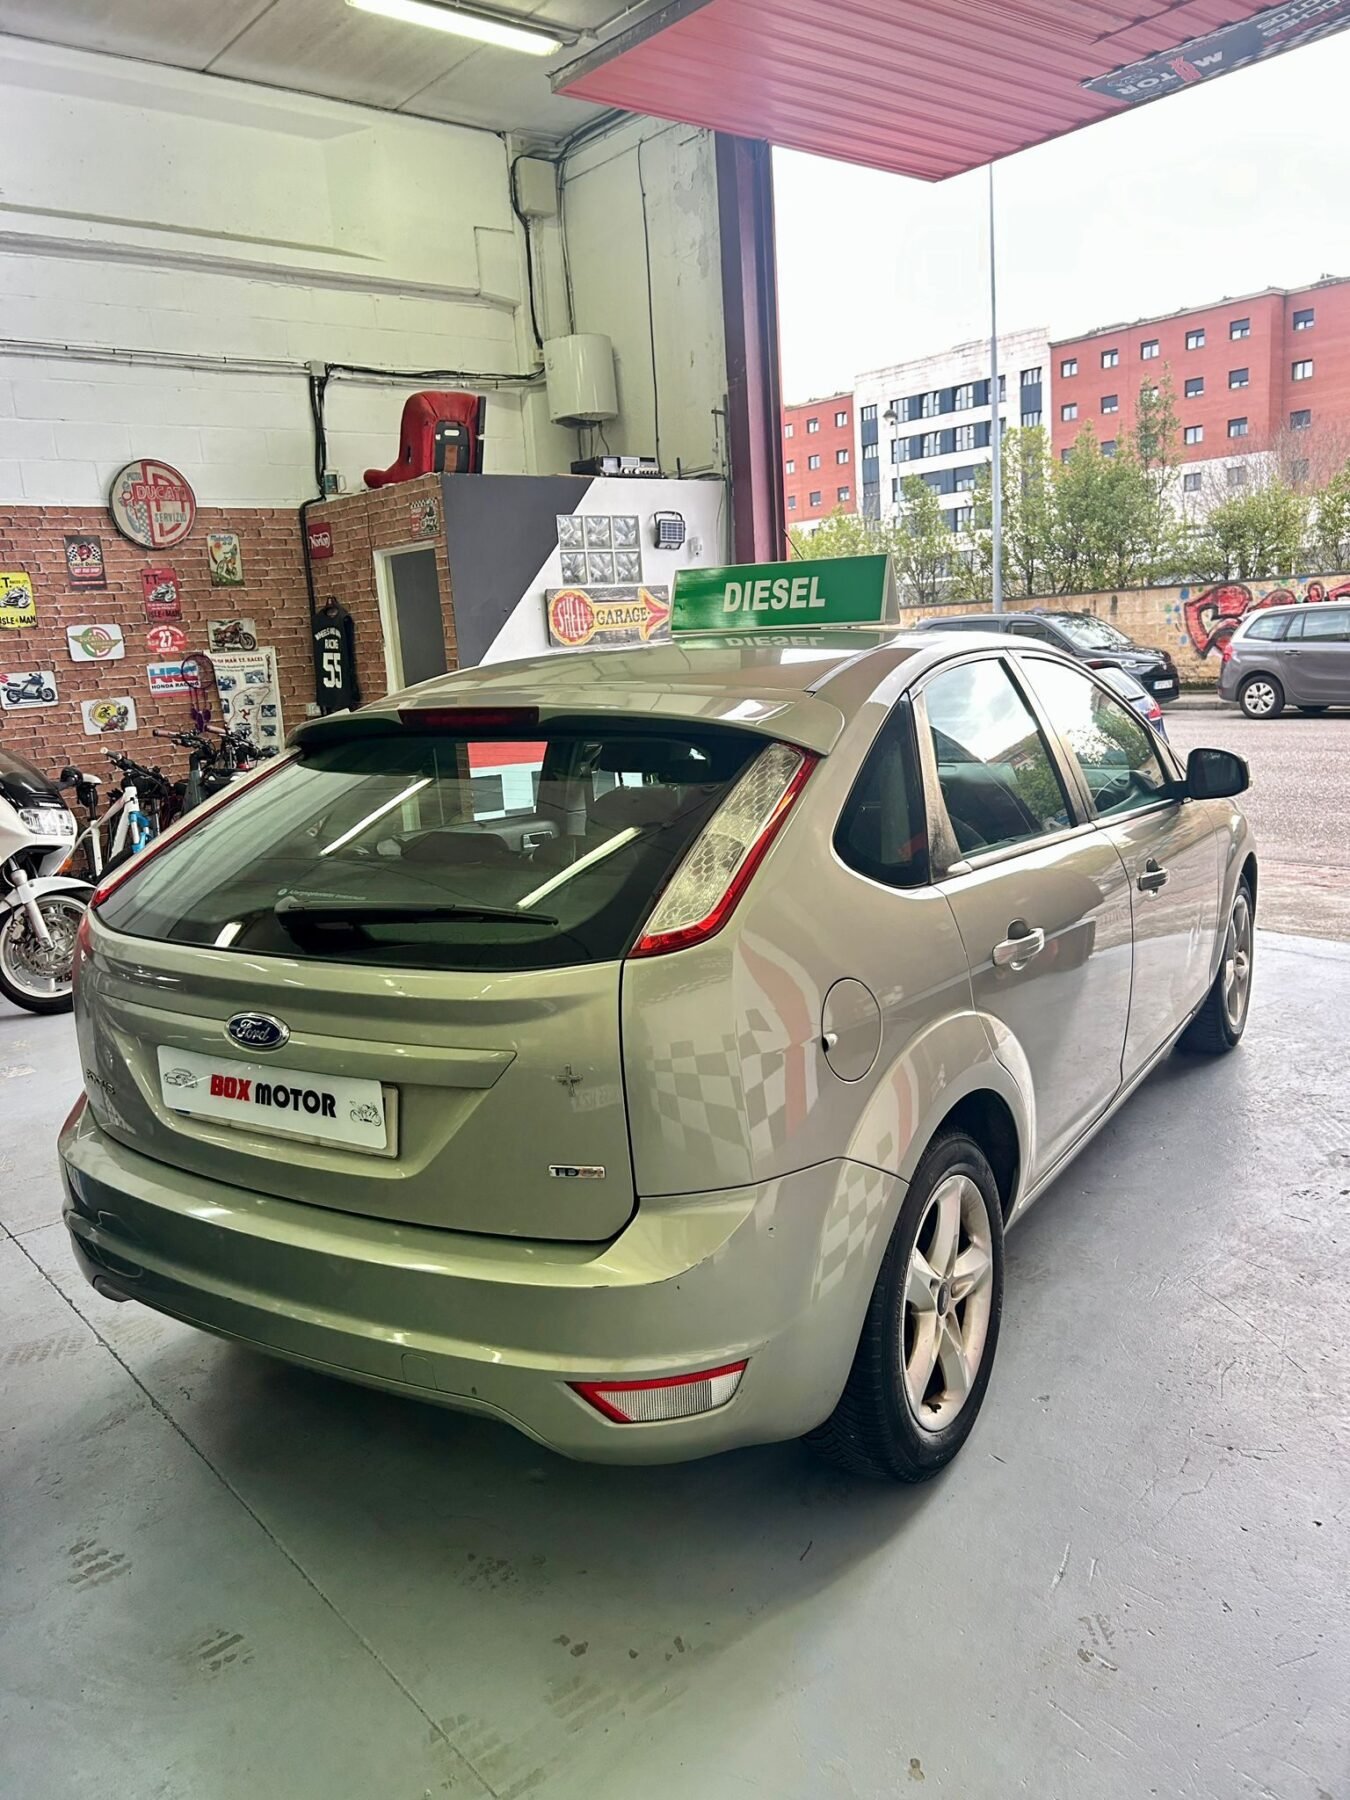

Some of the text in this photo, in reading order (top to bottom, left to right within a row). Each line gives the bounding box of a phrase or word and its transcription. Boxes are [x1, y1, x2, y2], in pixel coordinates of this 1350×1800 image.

[1256, 0, 1319, 30] OTOS
[1262, 0, 1341, 37] OCHES
[135, 485, 187, 501] DUCATI
[722, 576, 826, 613] DIESEL
[19, 615, 36, 624] MAN
[557, 597, 648, 637] SHELL GARAGE
[159, 631, 172, 648] 27
[149, 665, 199, 685] HRC
[323, 652, 342, 689] 55
[236, 1018, 270, 1042] Ford
[210, 1073, 337, 1119] BOX MOTOR
